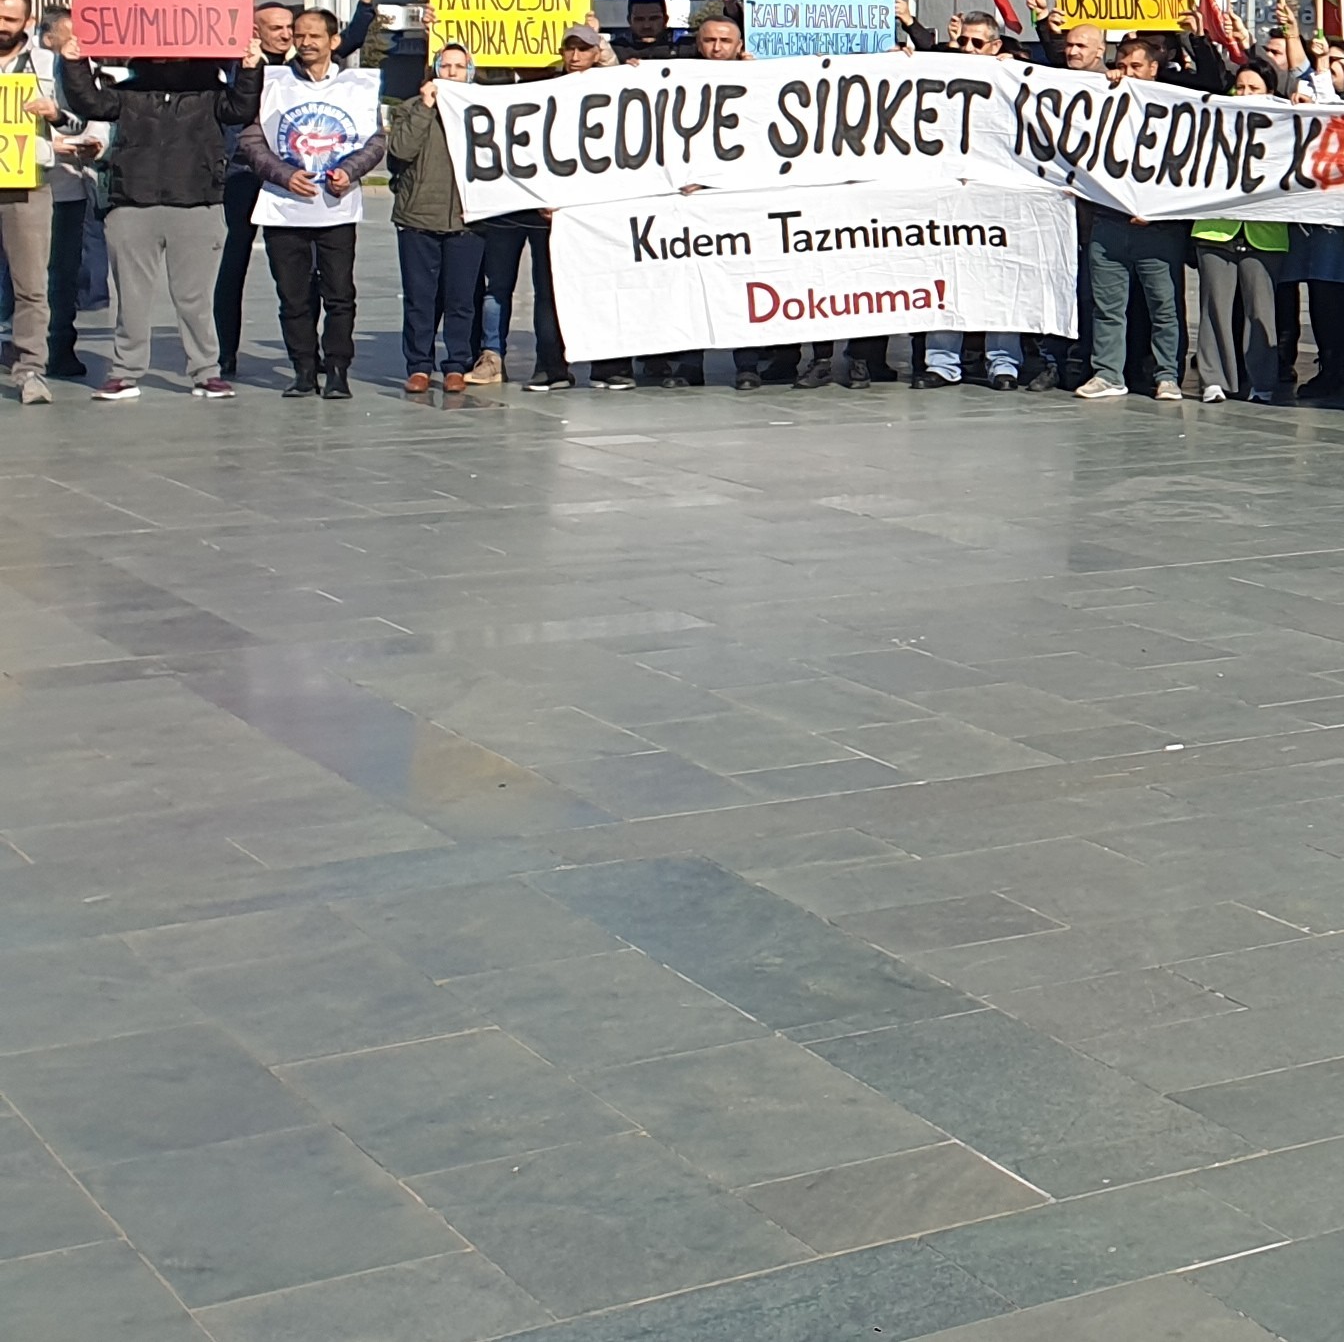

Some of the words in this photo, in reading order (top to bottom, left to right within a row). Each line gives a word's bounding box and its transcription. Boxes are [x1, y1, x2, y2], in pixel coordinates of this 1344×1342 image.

[805, 4, 891, 29] HAYALLER
[463, 67, 748, 183] BELEDİYE
[767, 58, 992, 176] ŞİRKET
[1013, 66, 1273, 195] İŞÇİLERİNE
[629, 214, 752, 262] Kıdem
[767, 210, 1009, 255] Tazminatıma
[745, 278, 948, 325] Dokunma!
